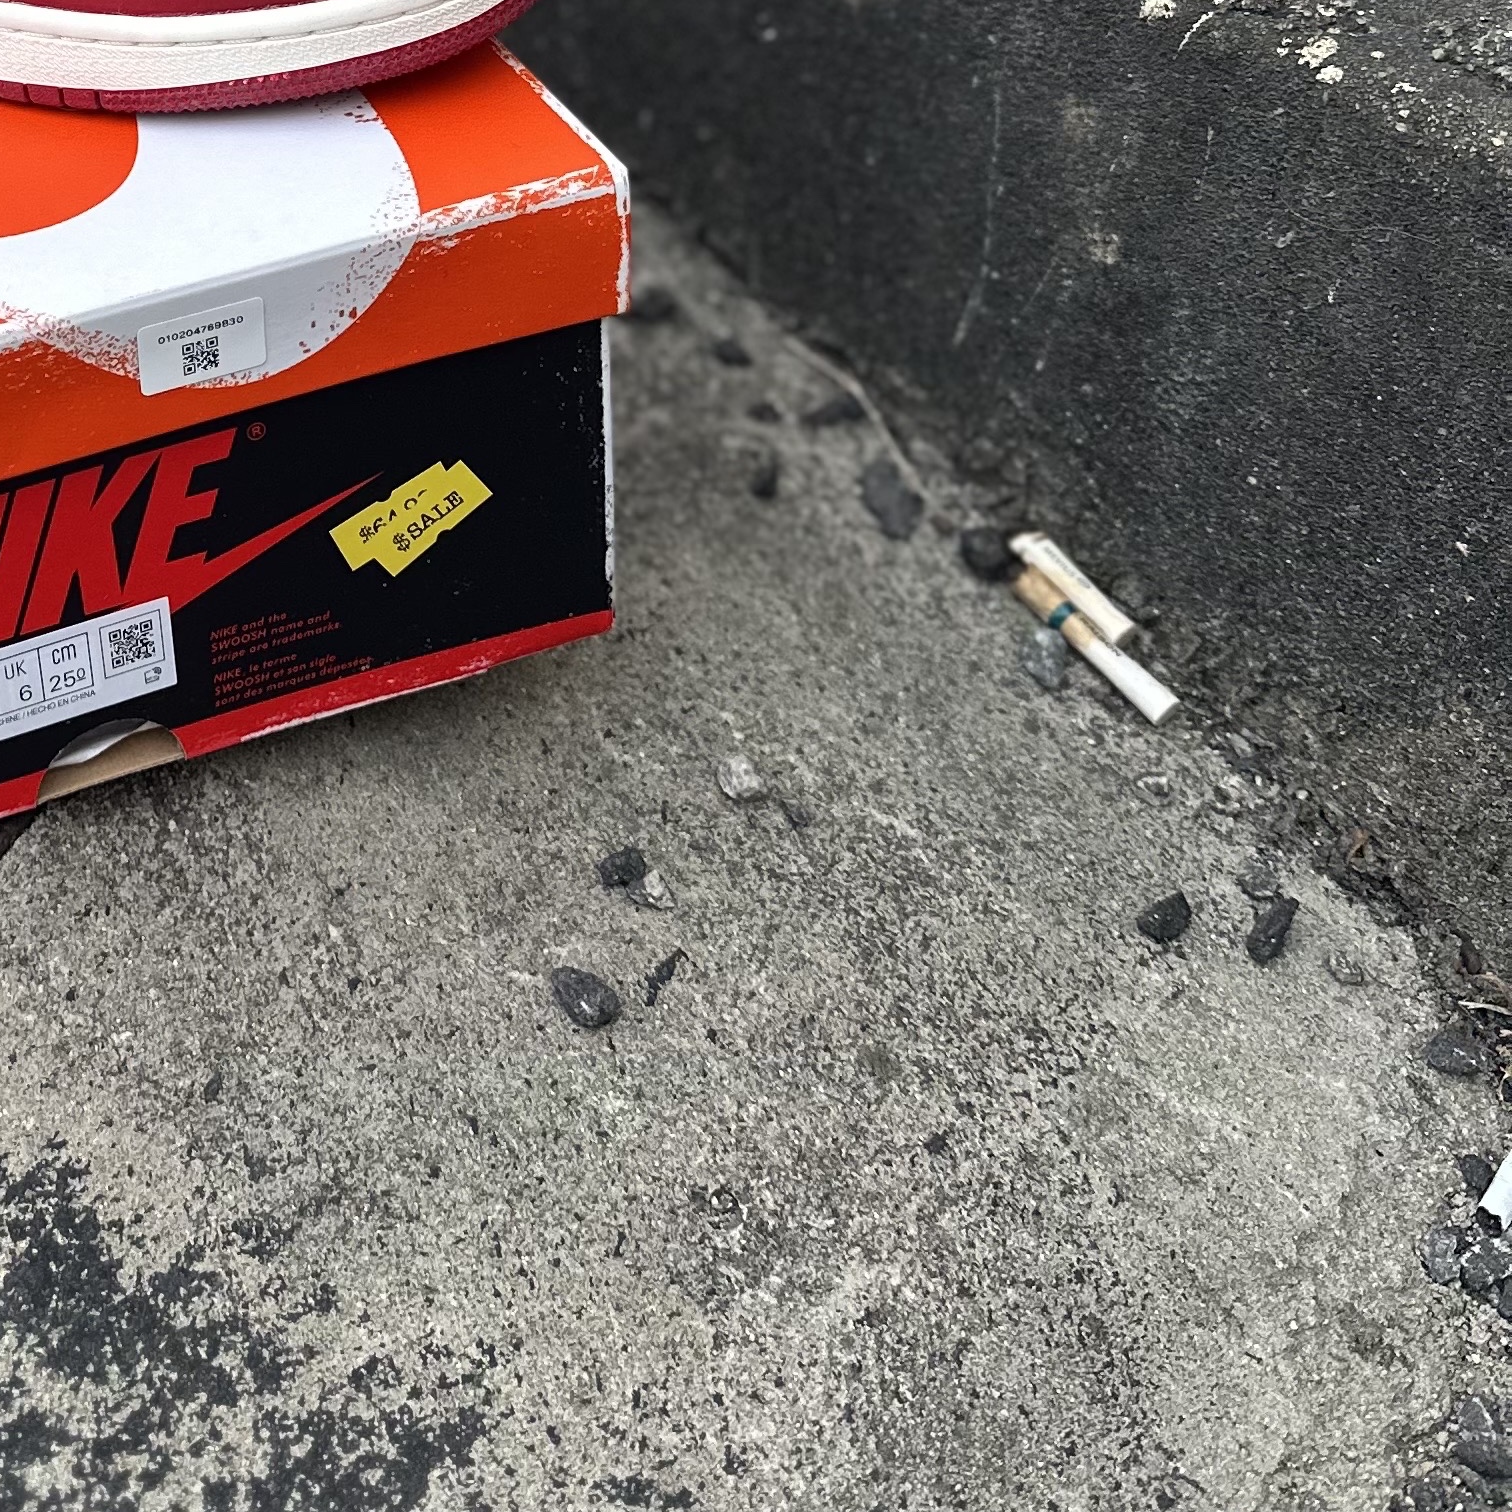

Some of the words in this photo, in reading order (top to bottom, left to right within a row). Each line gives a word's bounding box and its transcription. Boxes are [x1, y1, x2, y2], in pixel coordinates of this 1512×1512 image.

[210, 624, 238, 641] NIKE
[241, 617, 265, 632] and
[268, 612, 287, 623] the
[211, 628, 267, 653] SWOOSH
[270, 619, 304, 636] name
[307, 610, 330, 625] and
[4, 659, 27, 680] UK
[19, 684, 33, 702] 6
[215, 671, 270, 696] SWOOSH
[26, 701, 57, 718] HECHO
[57, 698, 70, 708] EN
[70, 689, 96, 704] CHINA
